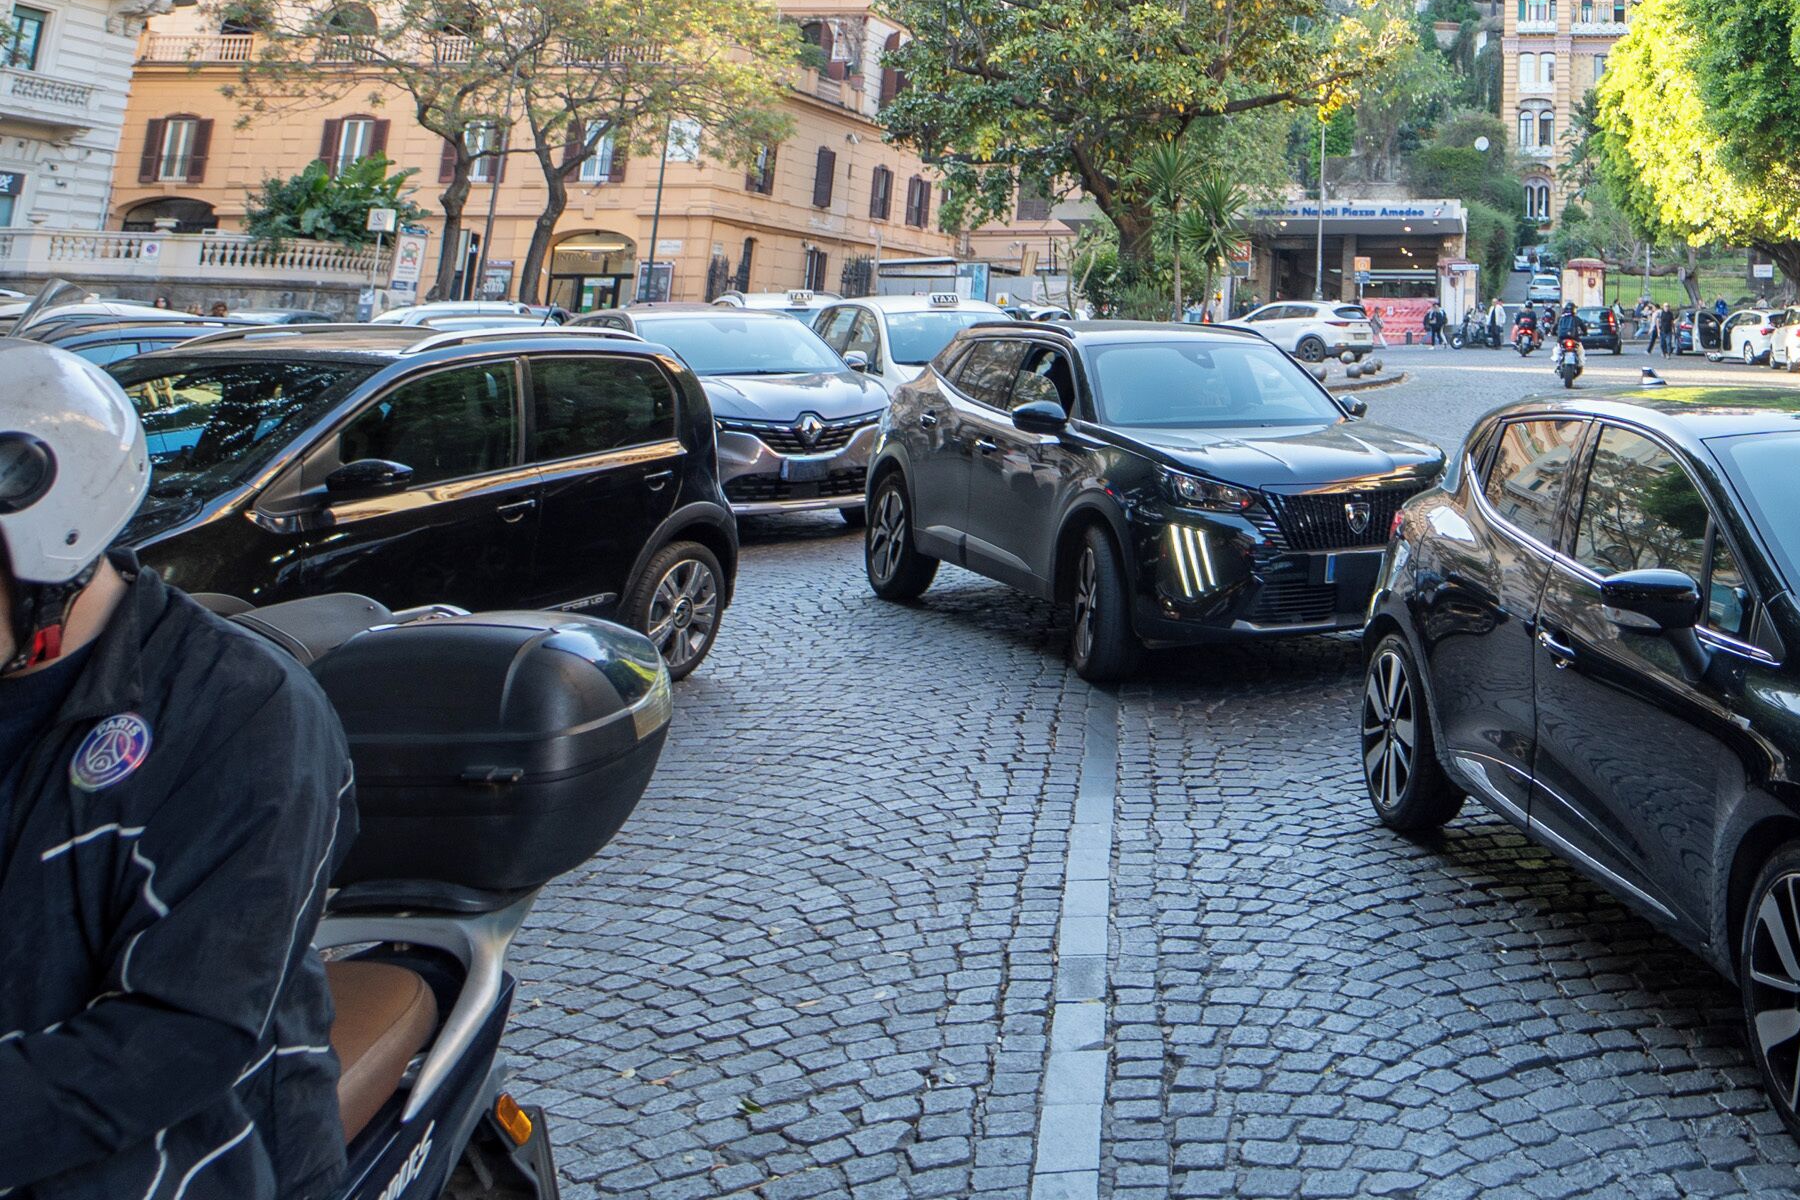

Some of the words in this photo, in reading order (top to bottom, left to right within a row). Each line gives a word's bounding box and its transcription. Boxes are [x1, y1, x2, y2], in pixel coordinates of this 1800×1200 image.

[1342, 207, 1376, 217] Piazza
[1380, 207, 1424, 217] Amedeo
[791, 292, 813, 301] TAXI
[933, 294, 959, 304] TAXI
[96, 718, 143, 738] PARIS
